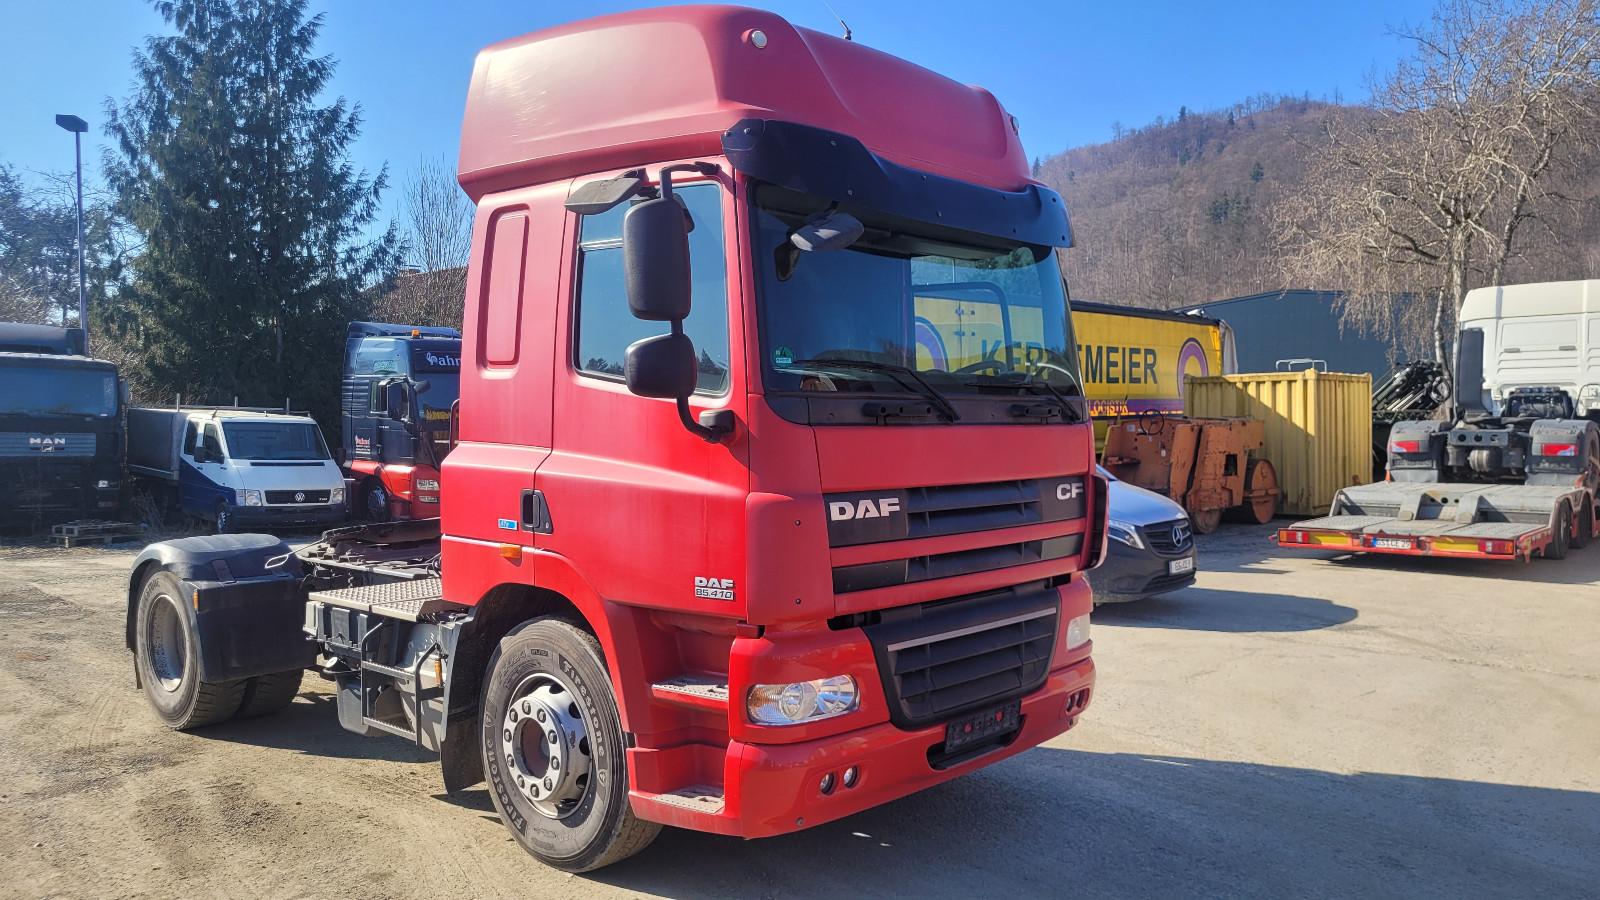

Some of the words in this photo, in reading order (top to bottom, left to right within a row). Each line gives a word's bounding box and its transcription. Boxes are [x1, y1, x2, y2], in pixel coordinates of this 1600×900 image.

[29, 437, 66, 445] MAN
[1056, 482, 1084, 501] CF
[829, 497, 900, 521] DAF
[694, 576, 734, 588] DAF
[695, 588, 733, 599] 85.410
